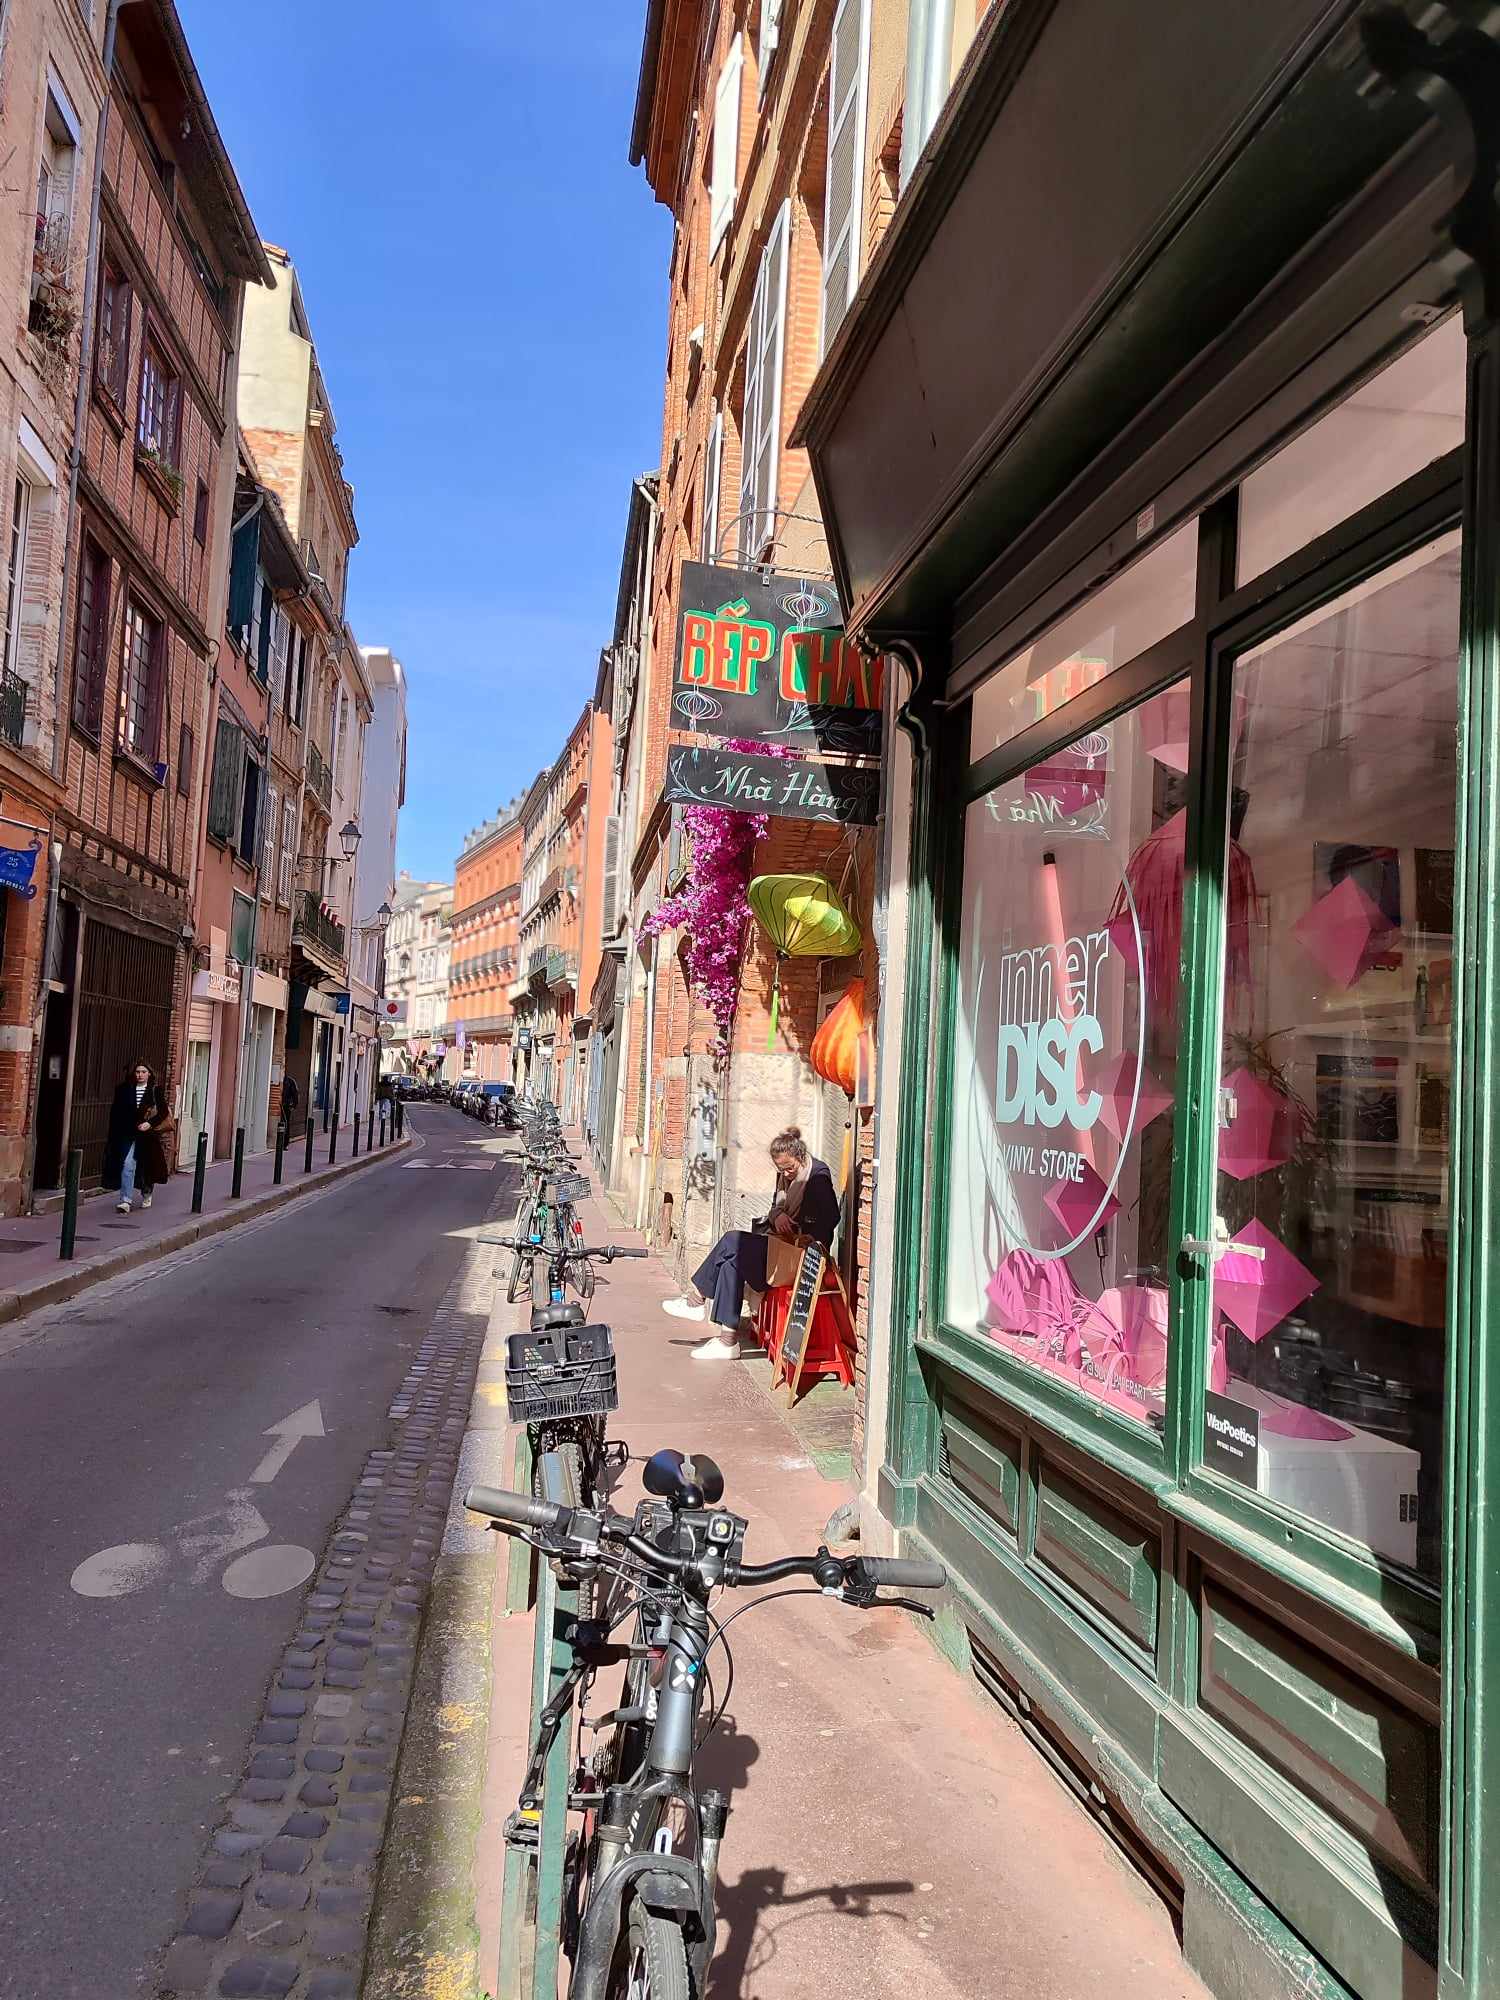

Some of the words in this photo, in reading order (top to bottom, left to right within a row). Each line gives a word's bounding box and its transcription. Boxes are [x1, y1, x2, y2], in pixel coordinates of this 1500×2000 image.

[701, 765, 774, 802] Nhà
[1000, 928, 1110, 1024] inner
[996, 1014, 1104, 1130] DISC
[1003, 1143, 1036, 1175] VINYL
[1039, 1149, 1087, 1183] STORE
[1206, 1411, 1257, 1448] WaxPoetics
